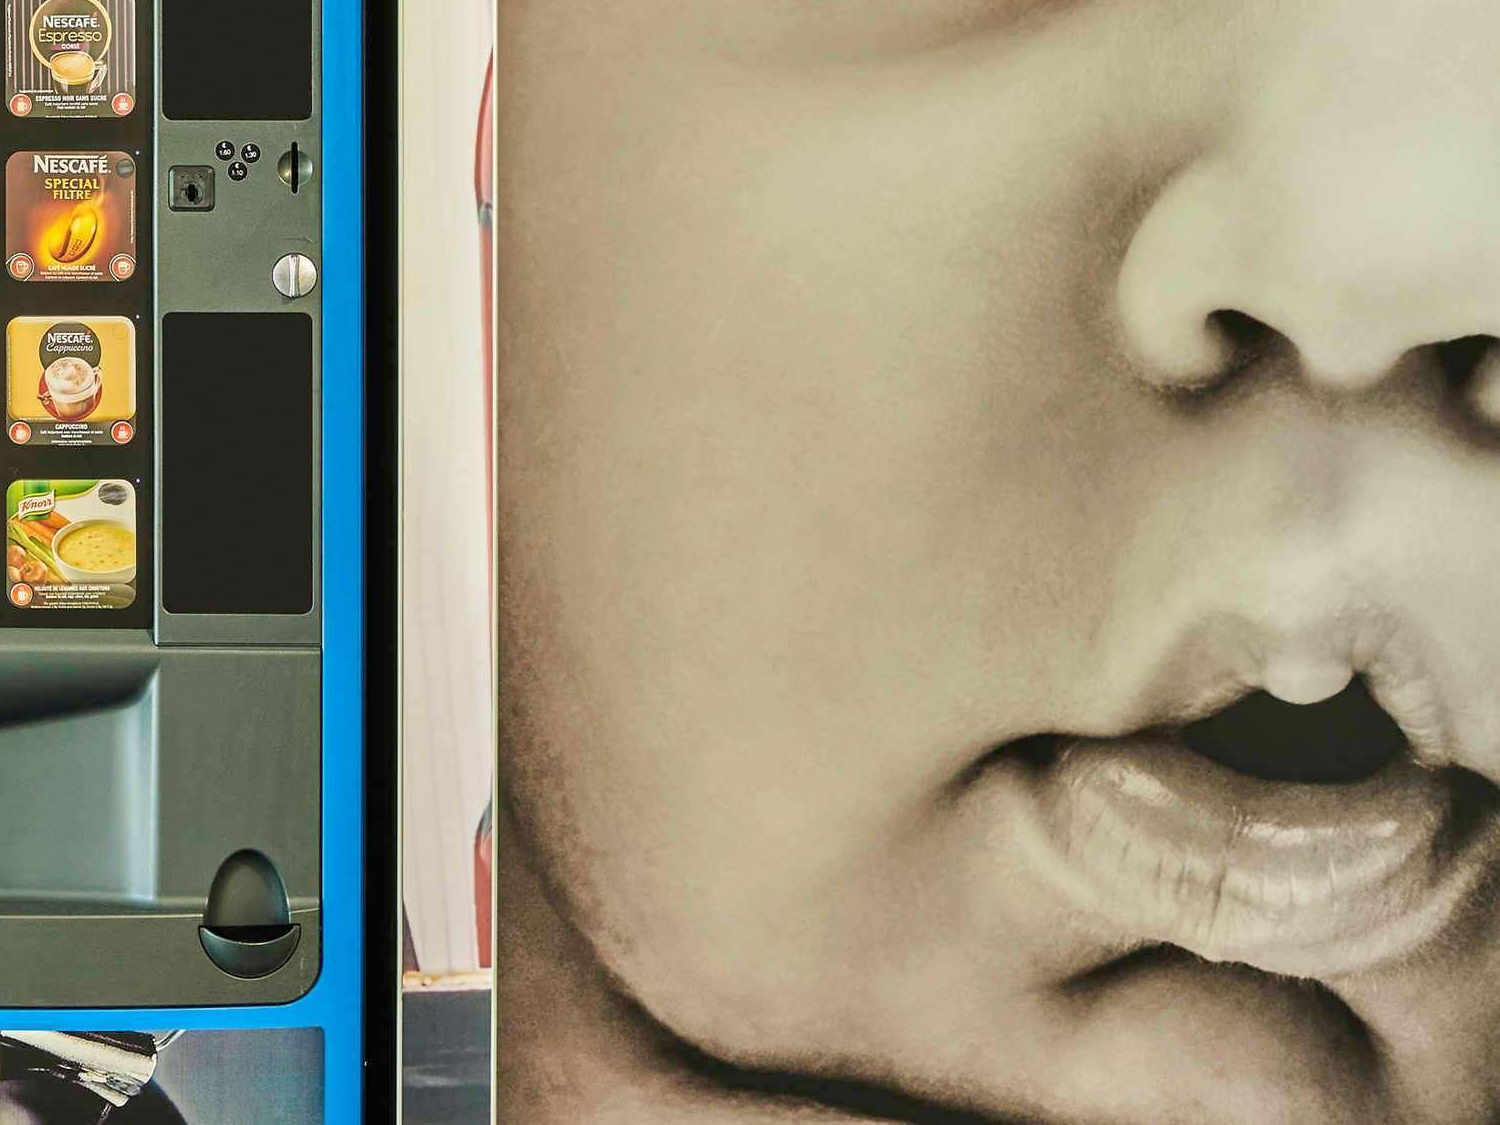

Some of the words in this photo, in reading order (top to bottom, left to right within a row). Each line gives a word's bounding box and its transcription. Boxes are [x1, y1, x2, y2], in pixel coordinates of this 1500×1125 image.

[38, 28, 102, 46] Espresso
[45, 178, 100, 190] SPECIAL
[53, 189, 92, 200] FILTRE
[46, 343, 94, 354] Cappuccino
[20, 498, 53, 512] Knorr
